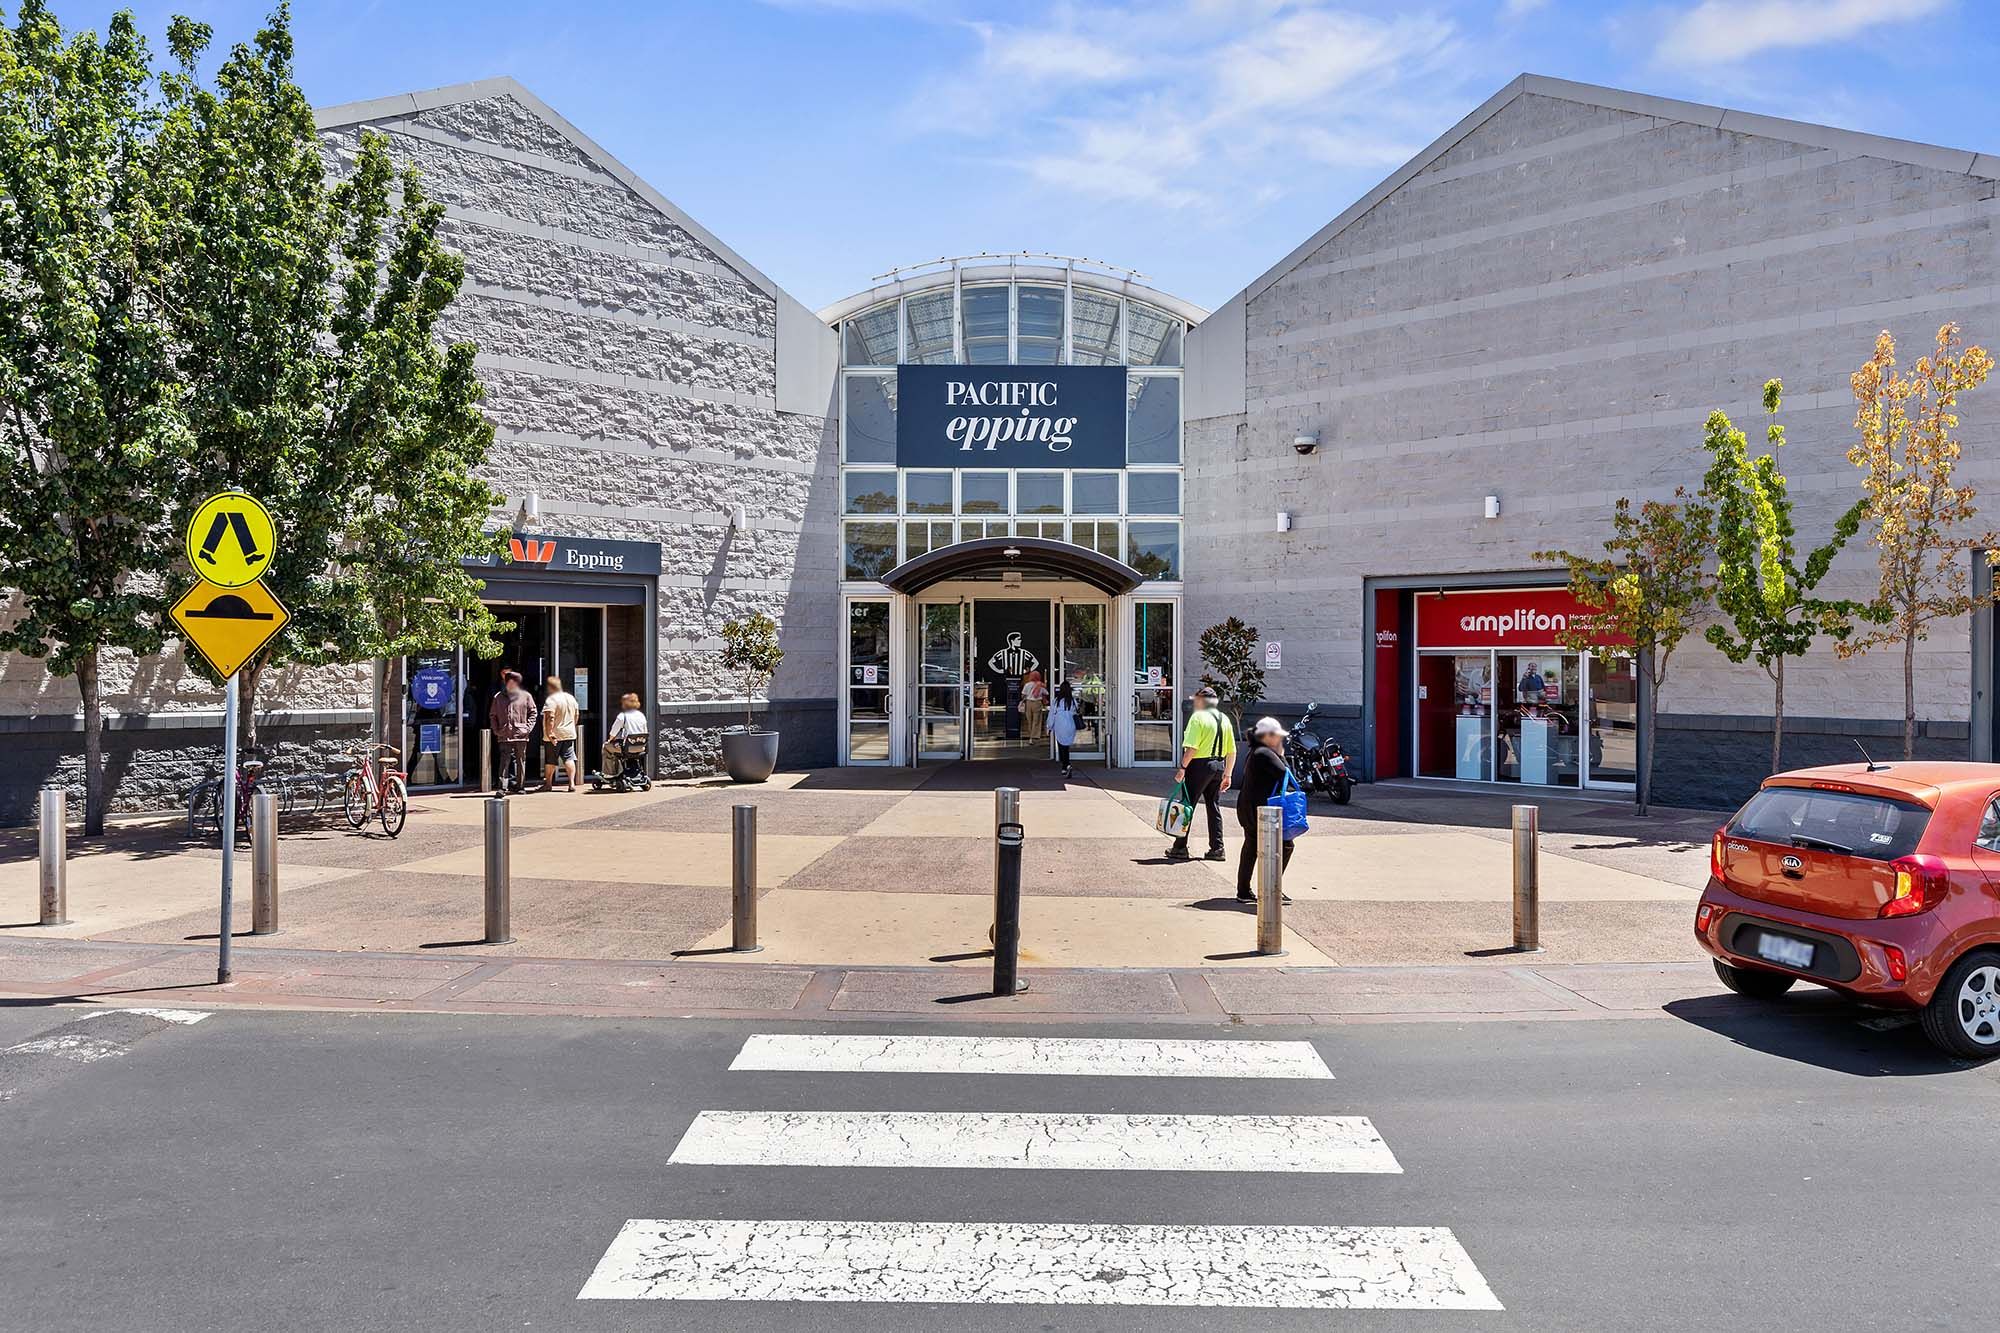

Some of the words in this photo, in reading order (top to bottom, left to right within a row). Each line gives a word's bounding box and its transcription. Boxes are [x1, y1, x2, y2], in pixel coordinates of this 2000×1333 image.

[945, 381, 1057, 406] PACIFIC
[946, 407, 1078, 452] epping
[566, 548, 624, 571] Epping
[1459, 609, 1566, 636] amplifon
[1784, 858, 1798, 867] KIA
